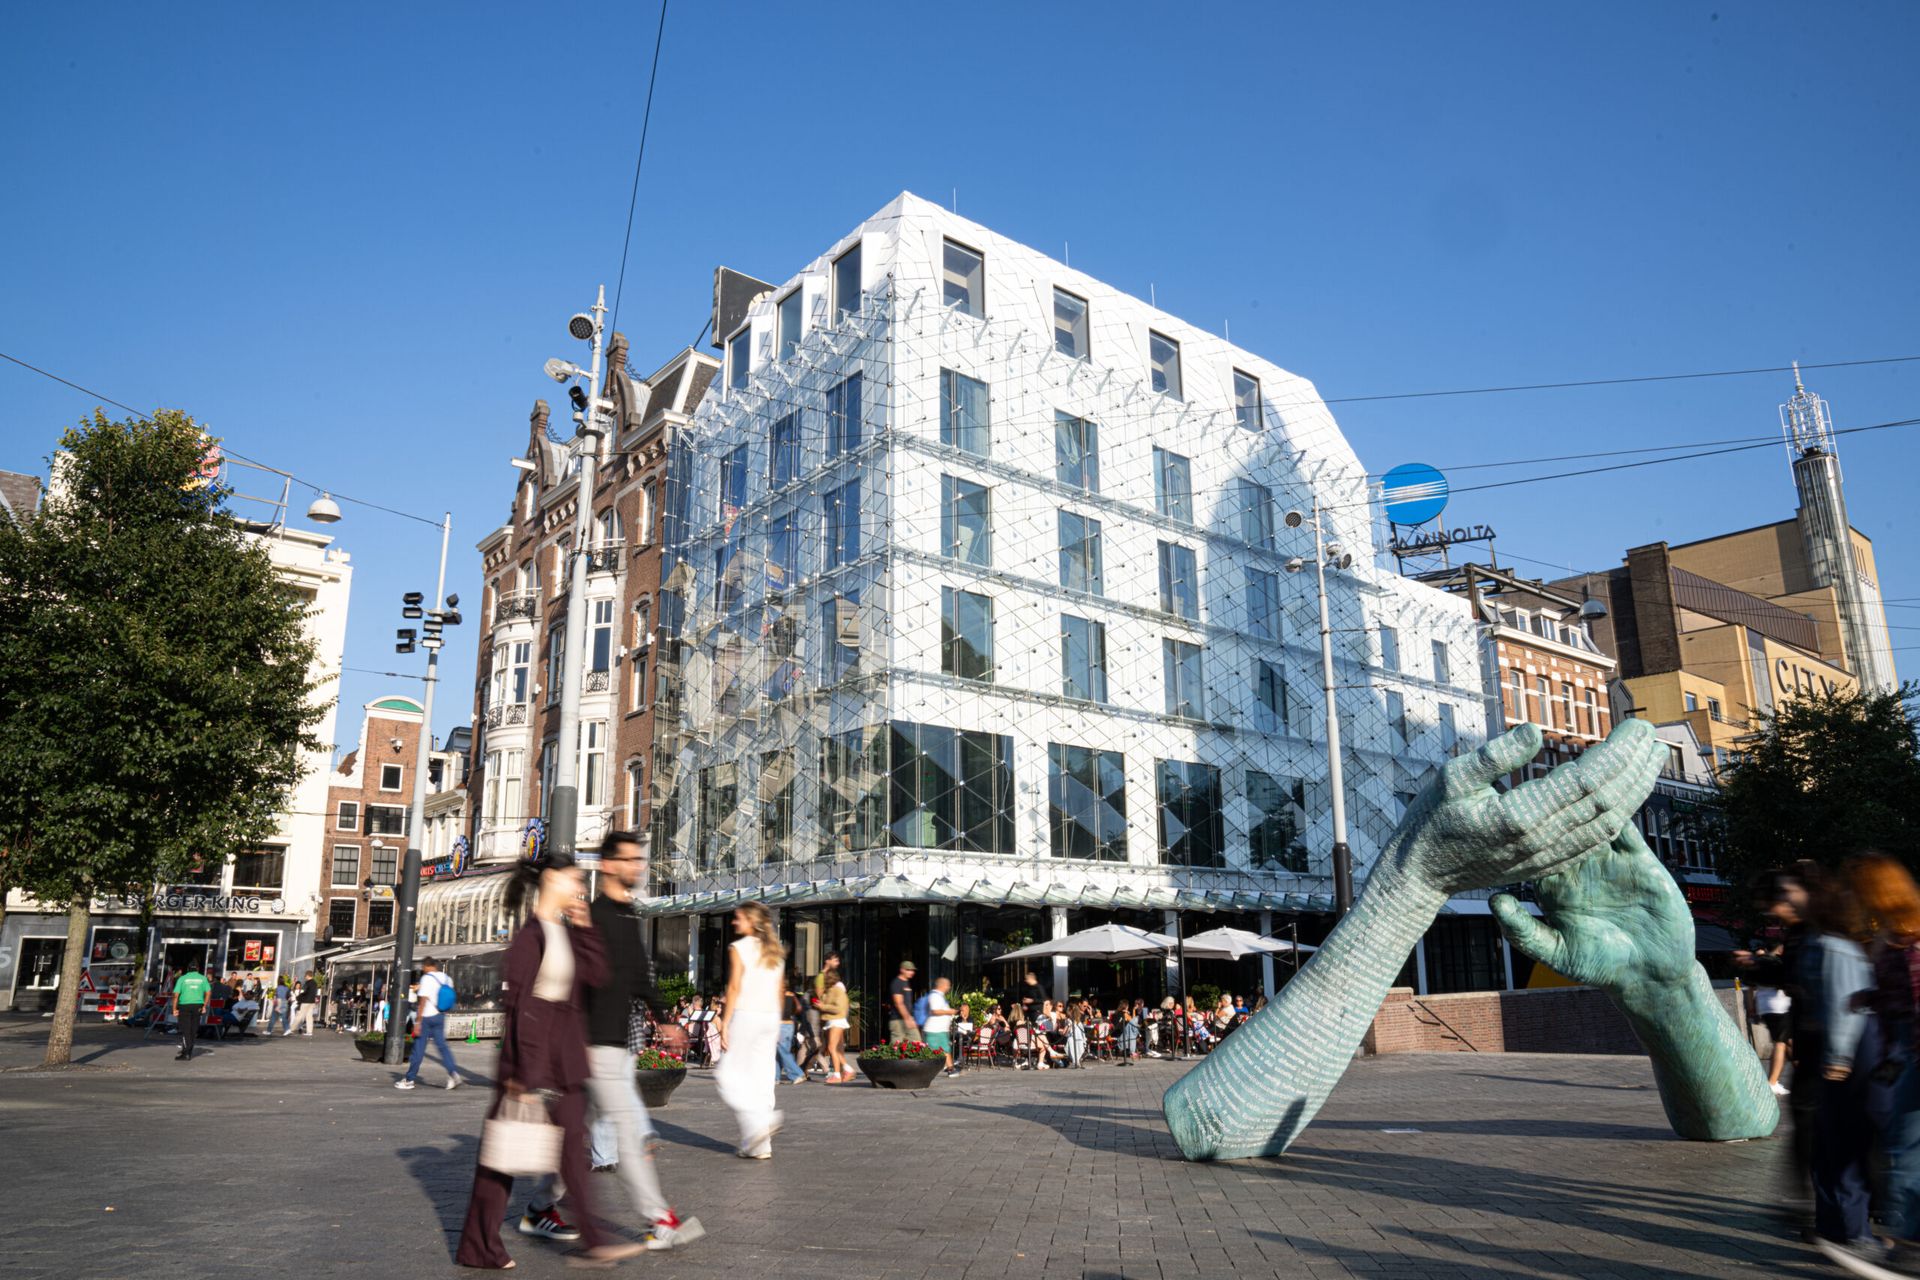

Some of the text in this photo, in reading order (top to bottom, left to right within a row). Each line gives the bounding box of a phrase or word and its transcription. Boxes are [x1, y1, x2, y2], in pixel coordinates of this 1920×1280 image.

[1415, 524, 1496, 547] MINOLTA
[1775, 658, 1834, 702] CITY
[211, 895, 260, 912] KING
